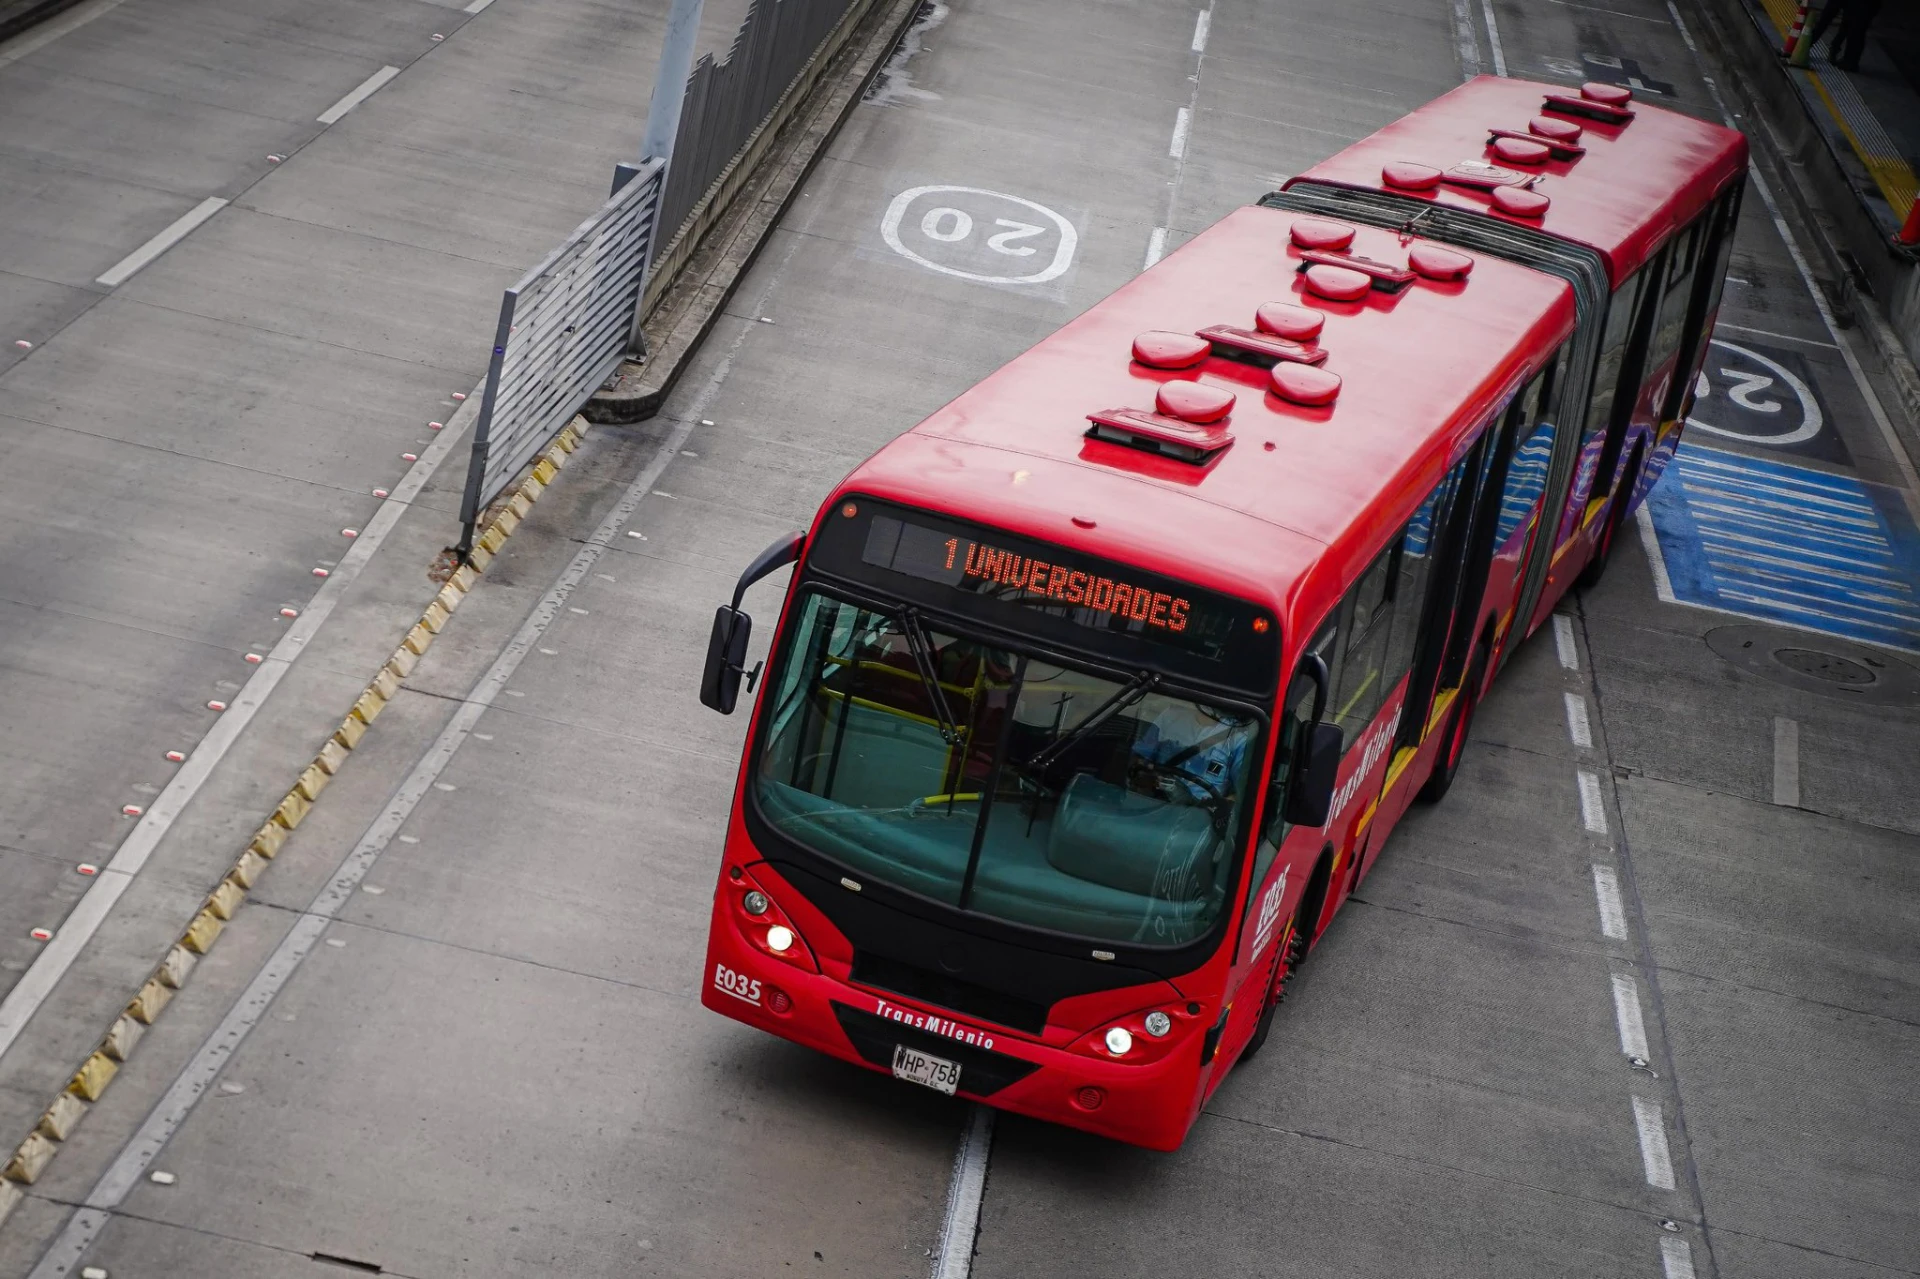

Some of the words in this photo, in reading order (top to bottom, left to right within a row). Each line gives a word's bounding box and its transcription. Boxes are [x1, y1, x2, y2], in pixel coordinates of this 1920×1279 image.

[921, 207, 1046, 256] 20
[945, 538, 957, 569] 1
[965, 543, 1190, 632] UNIVERSIDADES
[715, 963, 761, 1000] E035
[876, 1000, 993, 1049] TransMilenio
